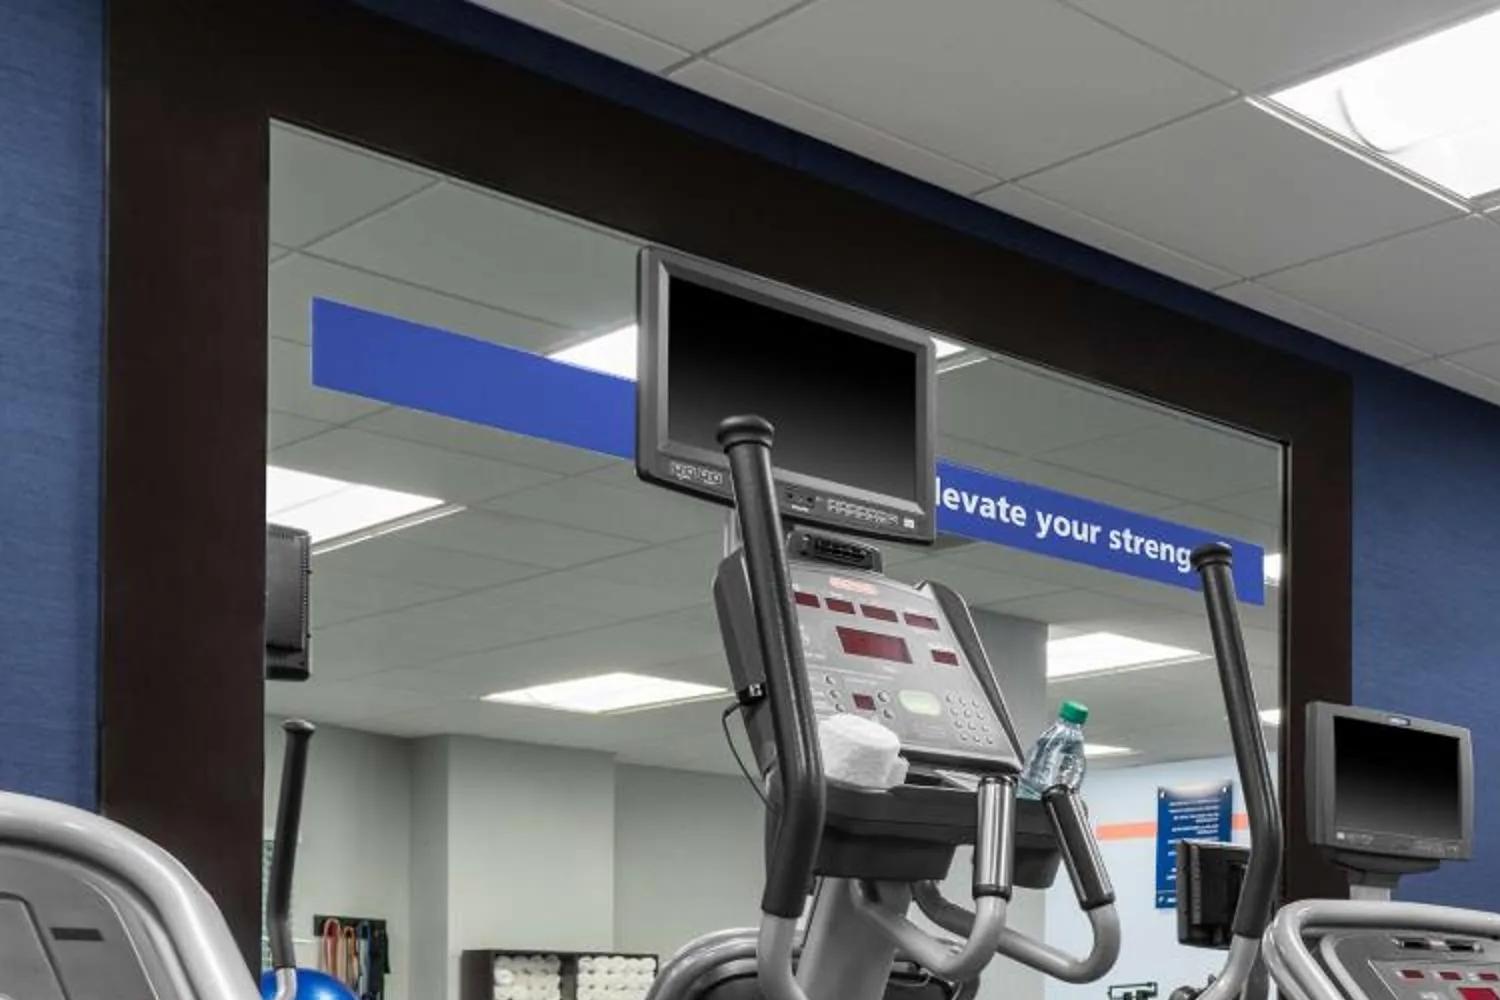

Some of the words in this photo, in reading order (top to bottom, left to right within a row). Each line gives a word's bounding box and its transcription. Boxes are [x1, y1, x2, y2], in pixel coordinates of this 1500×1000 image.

[936, 477, 1028, 527] levate
[1036, 509, 1101, 545] your
[1109, 528, 1192, 573] streng
